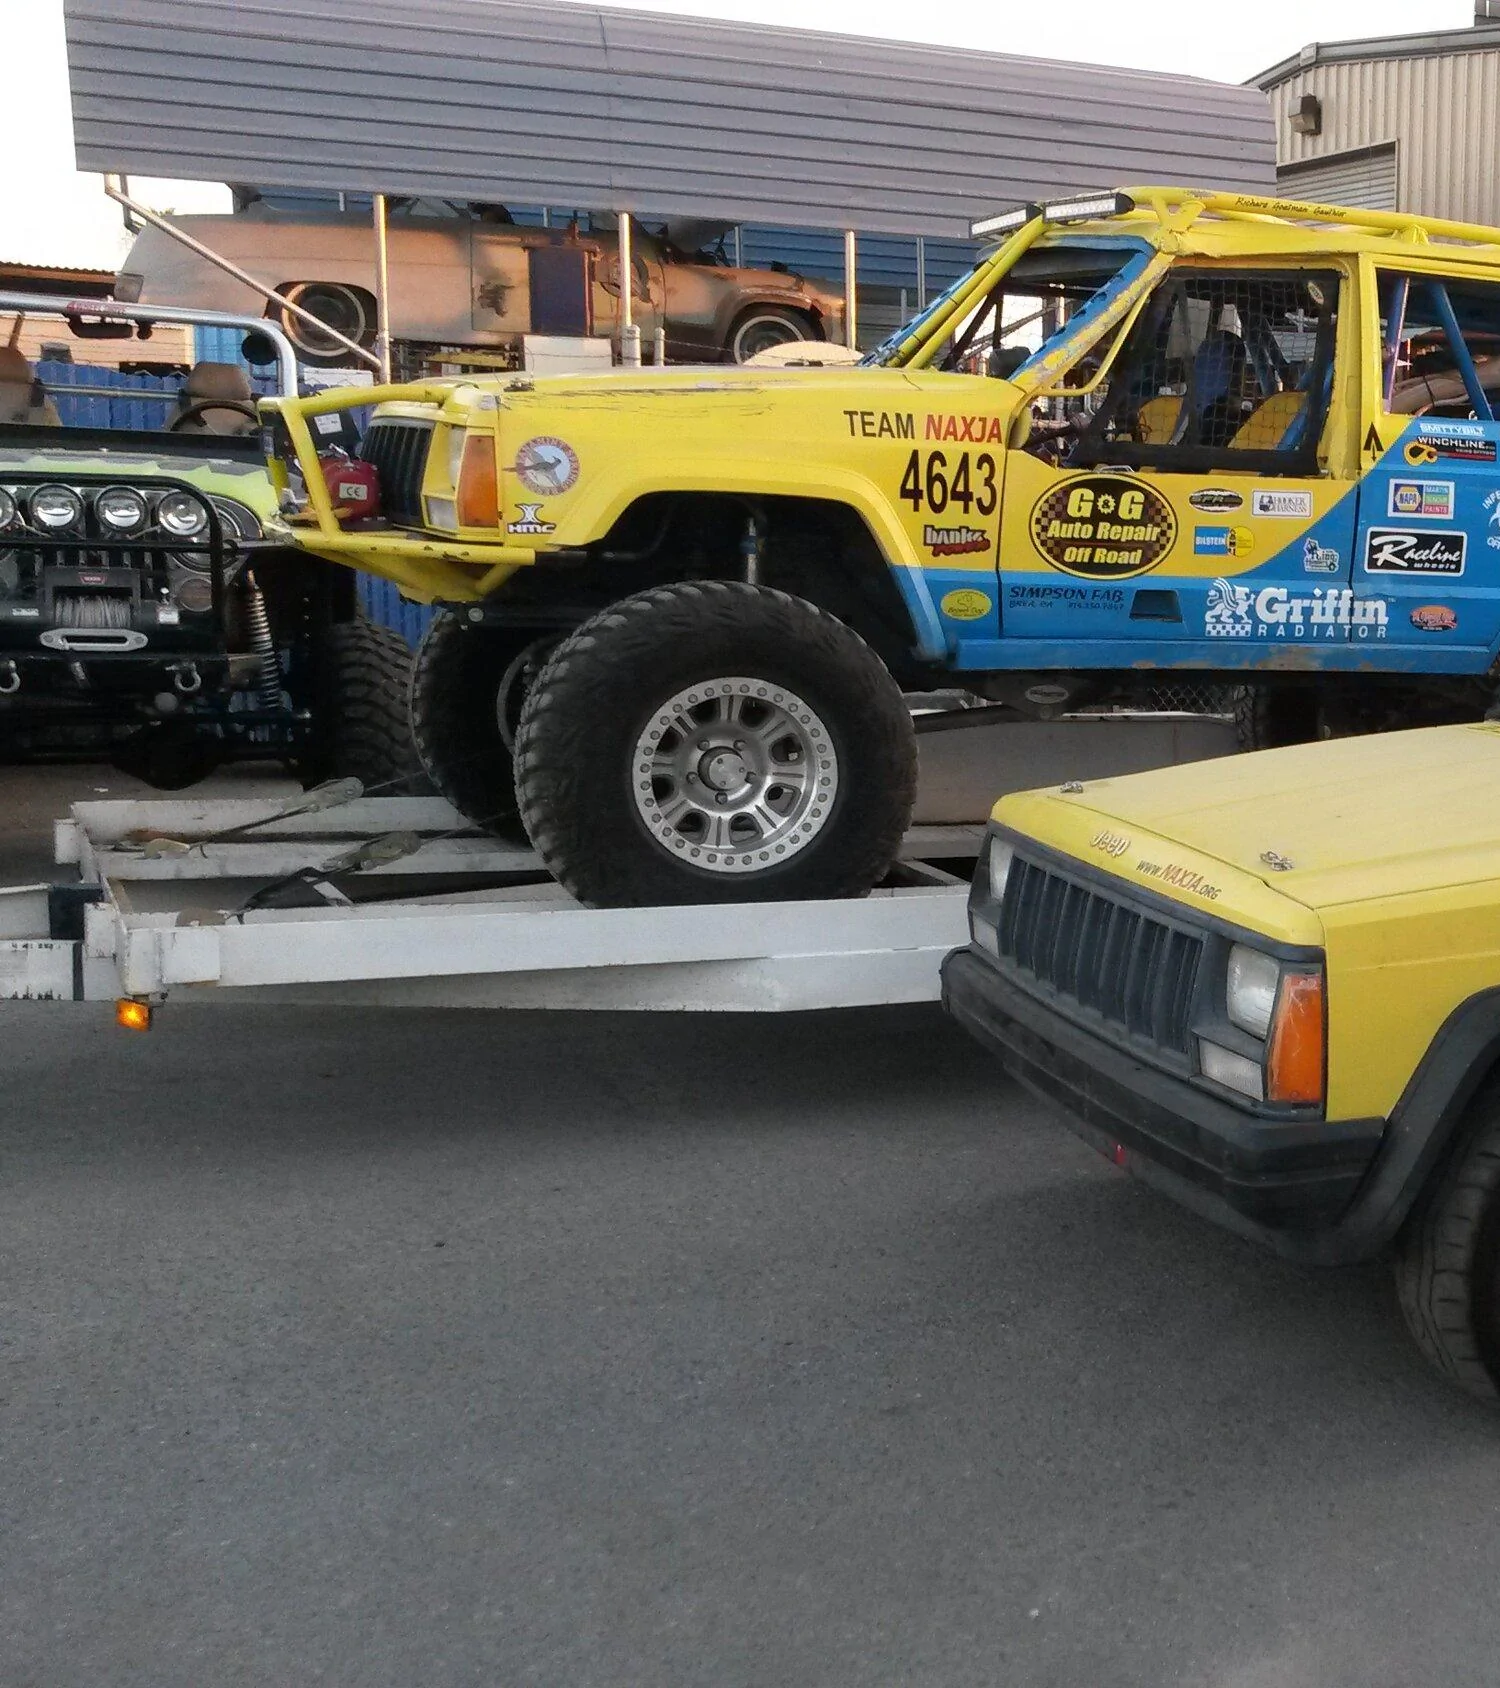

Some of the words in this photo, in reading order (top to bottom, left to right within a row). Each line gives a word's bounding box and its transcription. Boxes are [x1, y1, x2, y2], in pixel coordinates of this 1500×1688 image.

[843, 410, 915, 439] TEAM
[925, 414, 1003, 444] NAXJA
[900, 449, 997, 516] 4643
[1400, 493, 1417, 504] NAPA
[1424, 505, 1448, 514] PAINTS
[1047, 520, 1093, 539] Auto
[1096, 522, 1161, 542] Repair
[1196, 536, 1226, 545] BILSTEIN
[1063, 547, 1093, 563] Off
[1093, 548, 1142, 565] Road
[1371, 534, 1461, 568] Raceline
[1413, 562, 1457, 570] wheels
[1009, 585, 1087, 600] SIMPSON
[1255, 587, 1389, 624] Griffin
[1258, 624, 1387, 638] RADIATOR
[1090, 830, 1131, 858] Jeep
